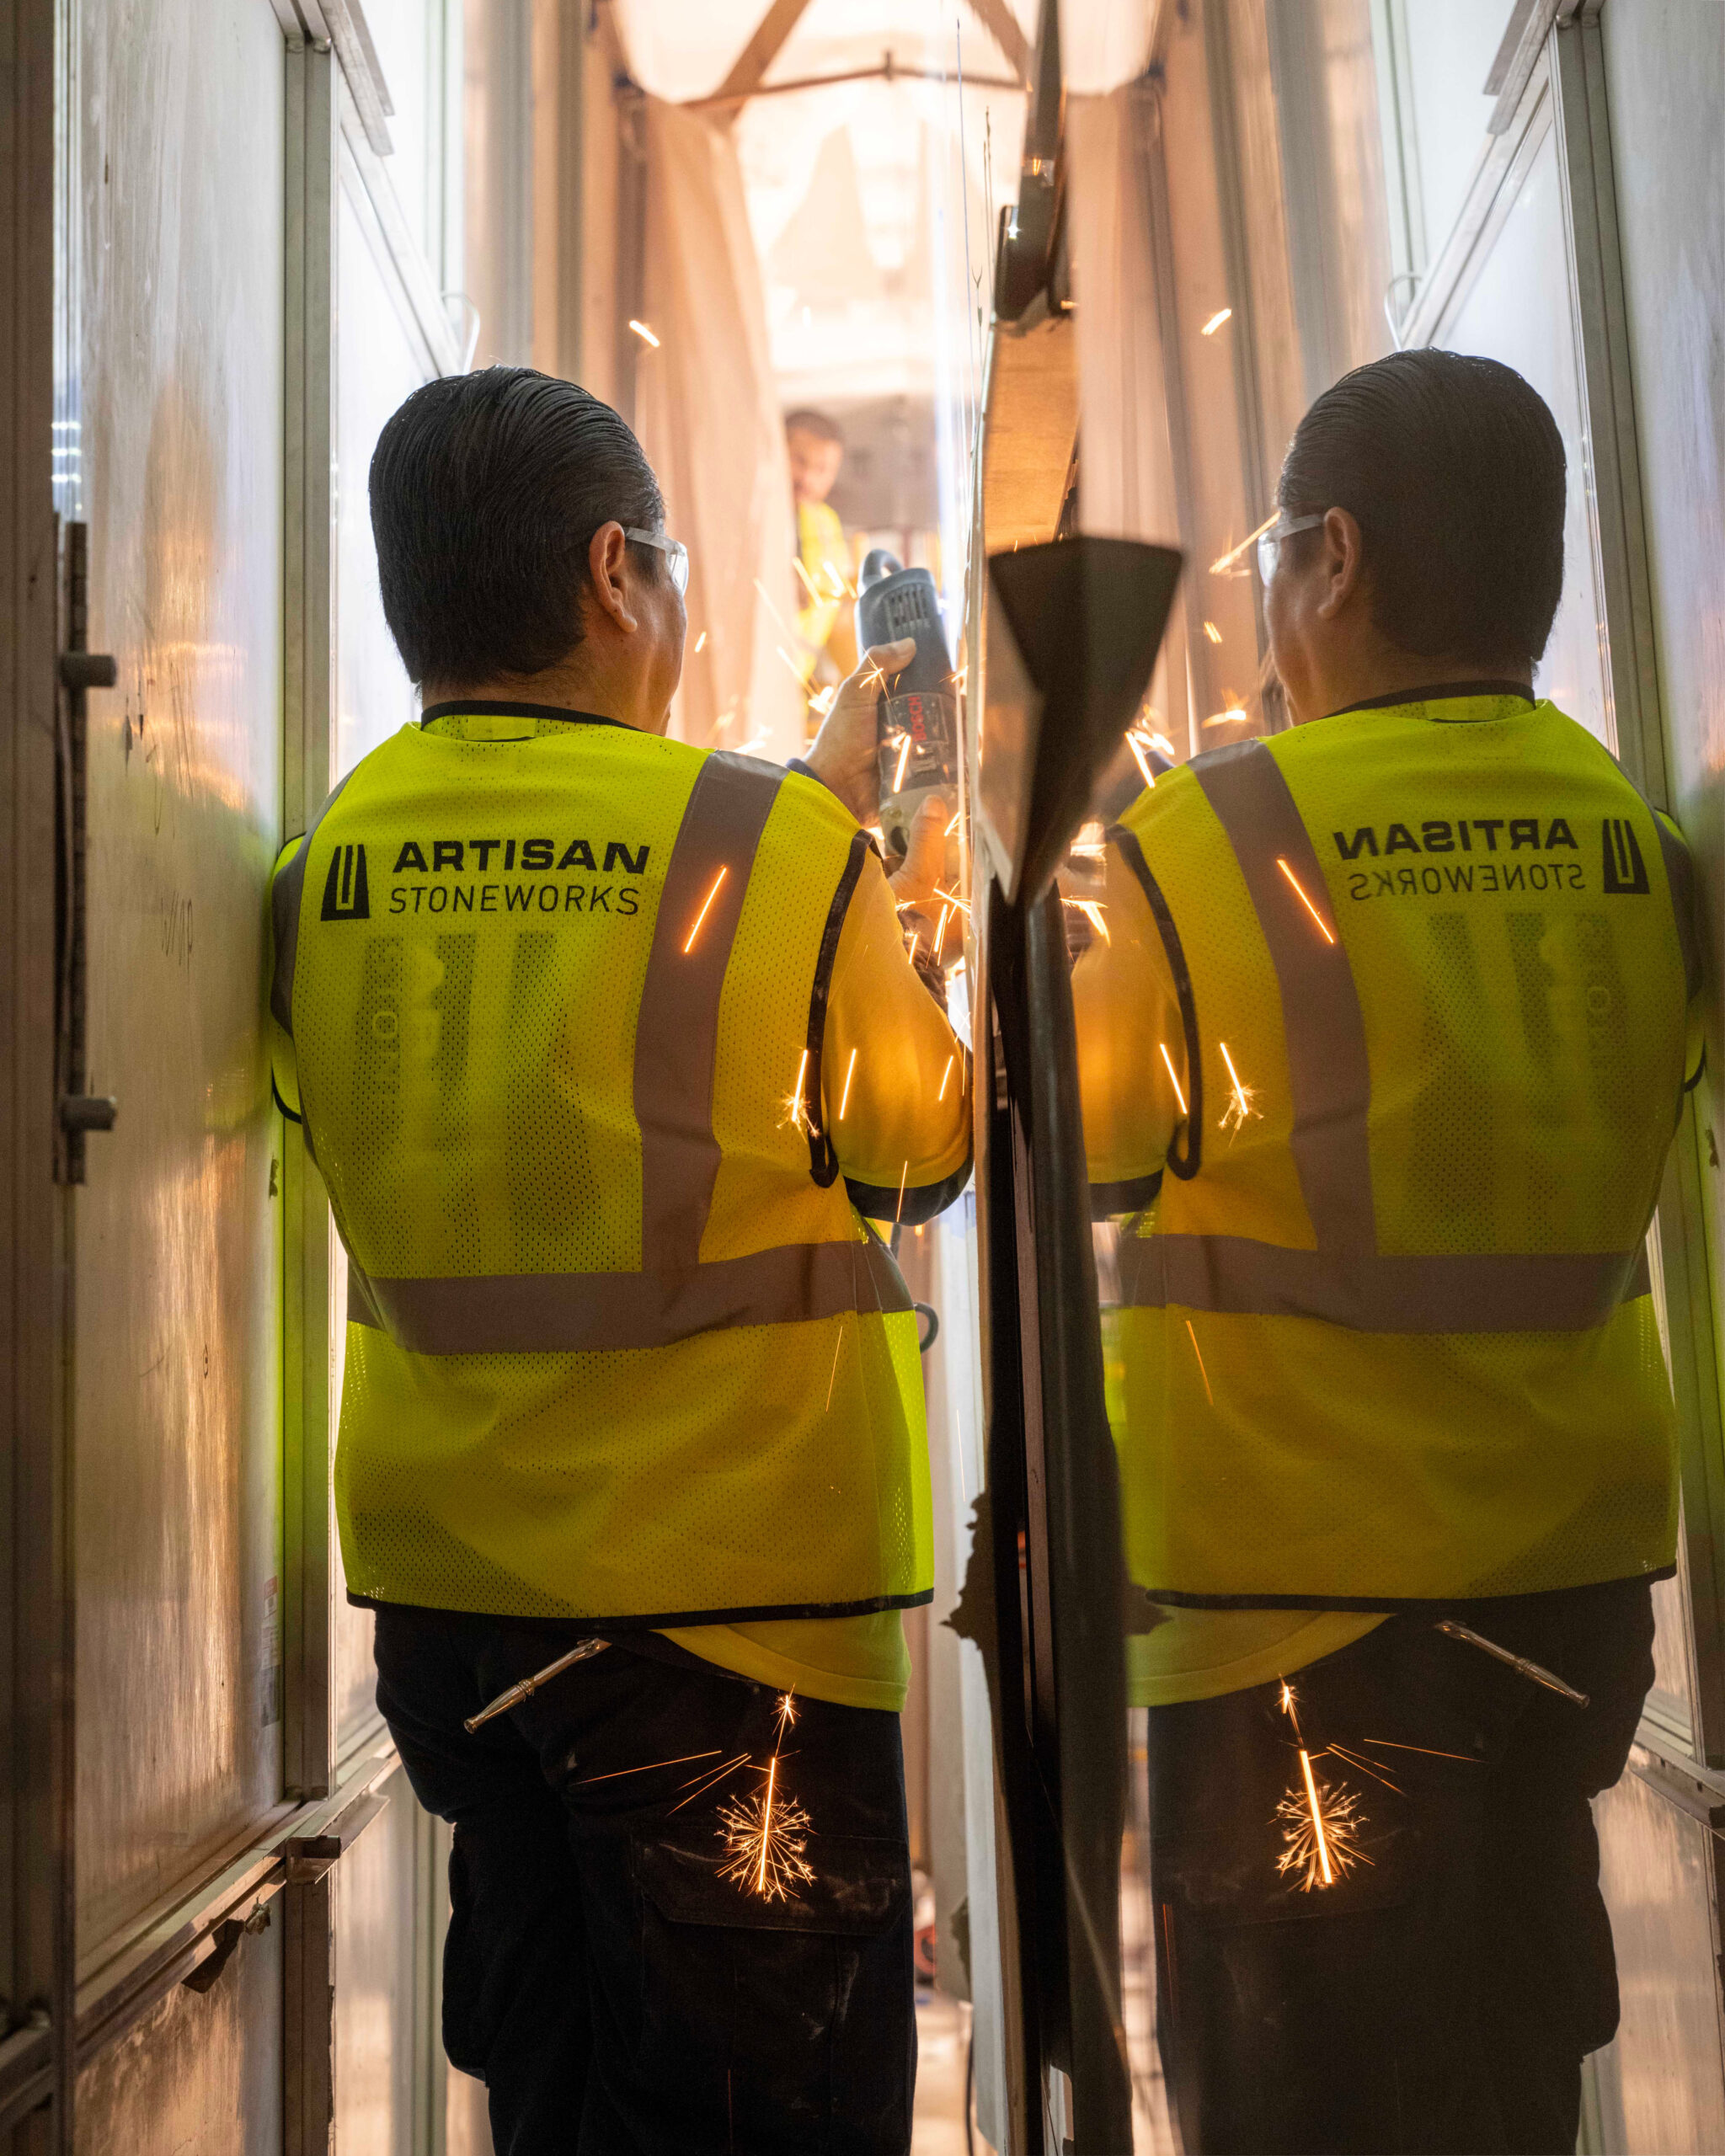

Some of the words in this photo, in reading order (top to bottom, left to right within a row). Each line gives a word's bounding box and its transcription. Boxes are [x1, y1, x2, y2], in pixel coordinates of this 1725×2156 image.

[908, 696, 927, 741] BOSCH
[393, 839, 650, 874] ARTISAN
[388, 884, 640, 915] STONEWORKS
